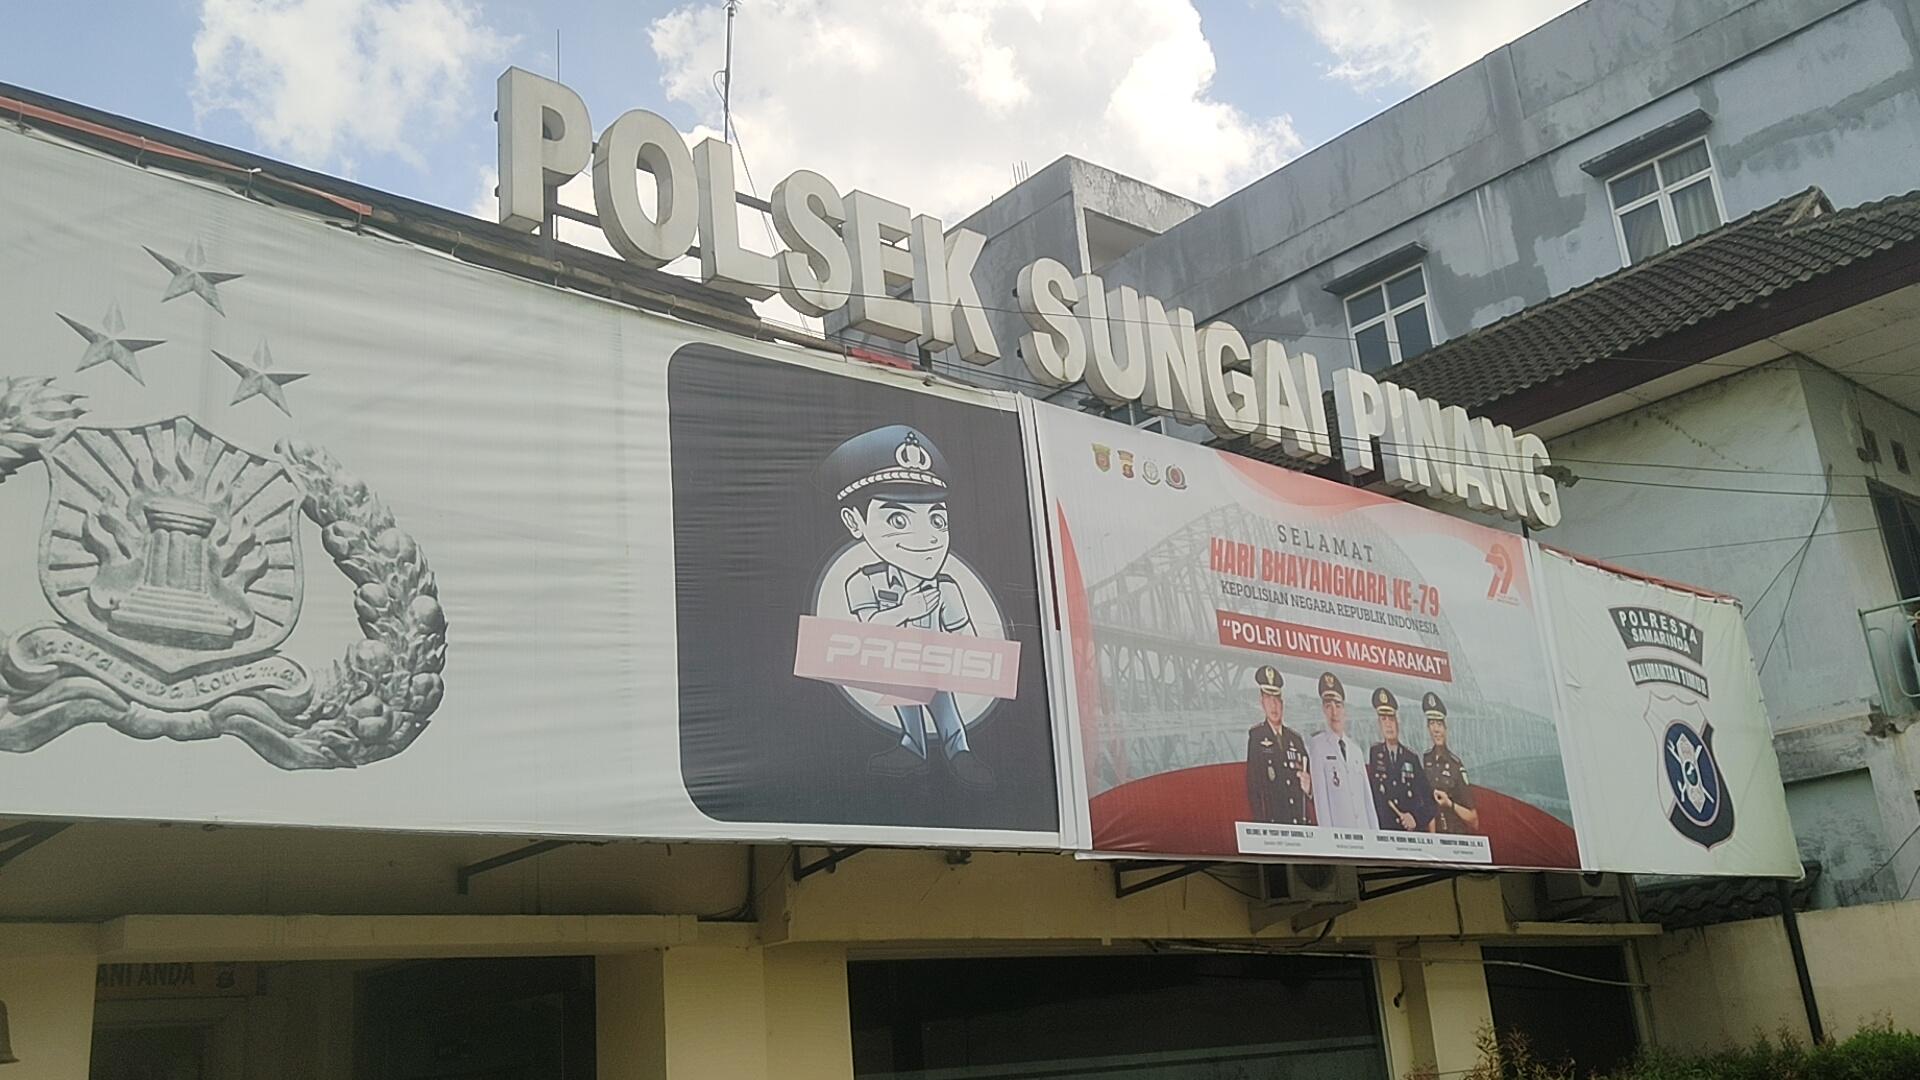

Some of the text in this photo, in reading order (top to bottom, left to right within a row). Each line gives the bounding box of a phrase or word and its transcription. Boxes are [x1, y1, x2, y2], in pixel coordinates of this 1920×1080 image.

[496, 66, 1562, 532] POLSEK SUNGAI PINANG
[1277, 523, 1374, 563] SELAMAT
[1210, 536, 1440, 617] HARI BHAYANGKARA KE-79
[1221, 579, 1440, 636] KEPOLISIAN NEGARA REPUBLIK INDONESIA
[1618, 609, 1698, 645] POLRESTA
[827, 634, 1000, 680] PRESISI
[1286, 629, 1344, 658] UNTUK
[1631, 627, 1691, 654] SAMARINDA
